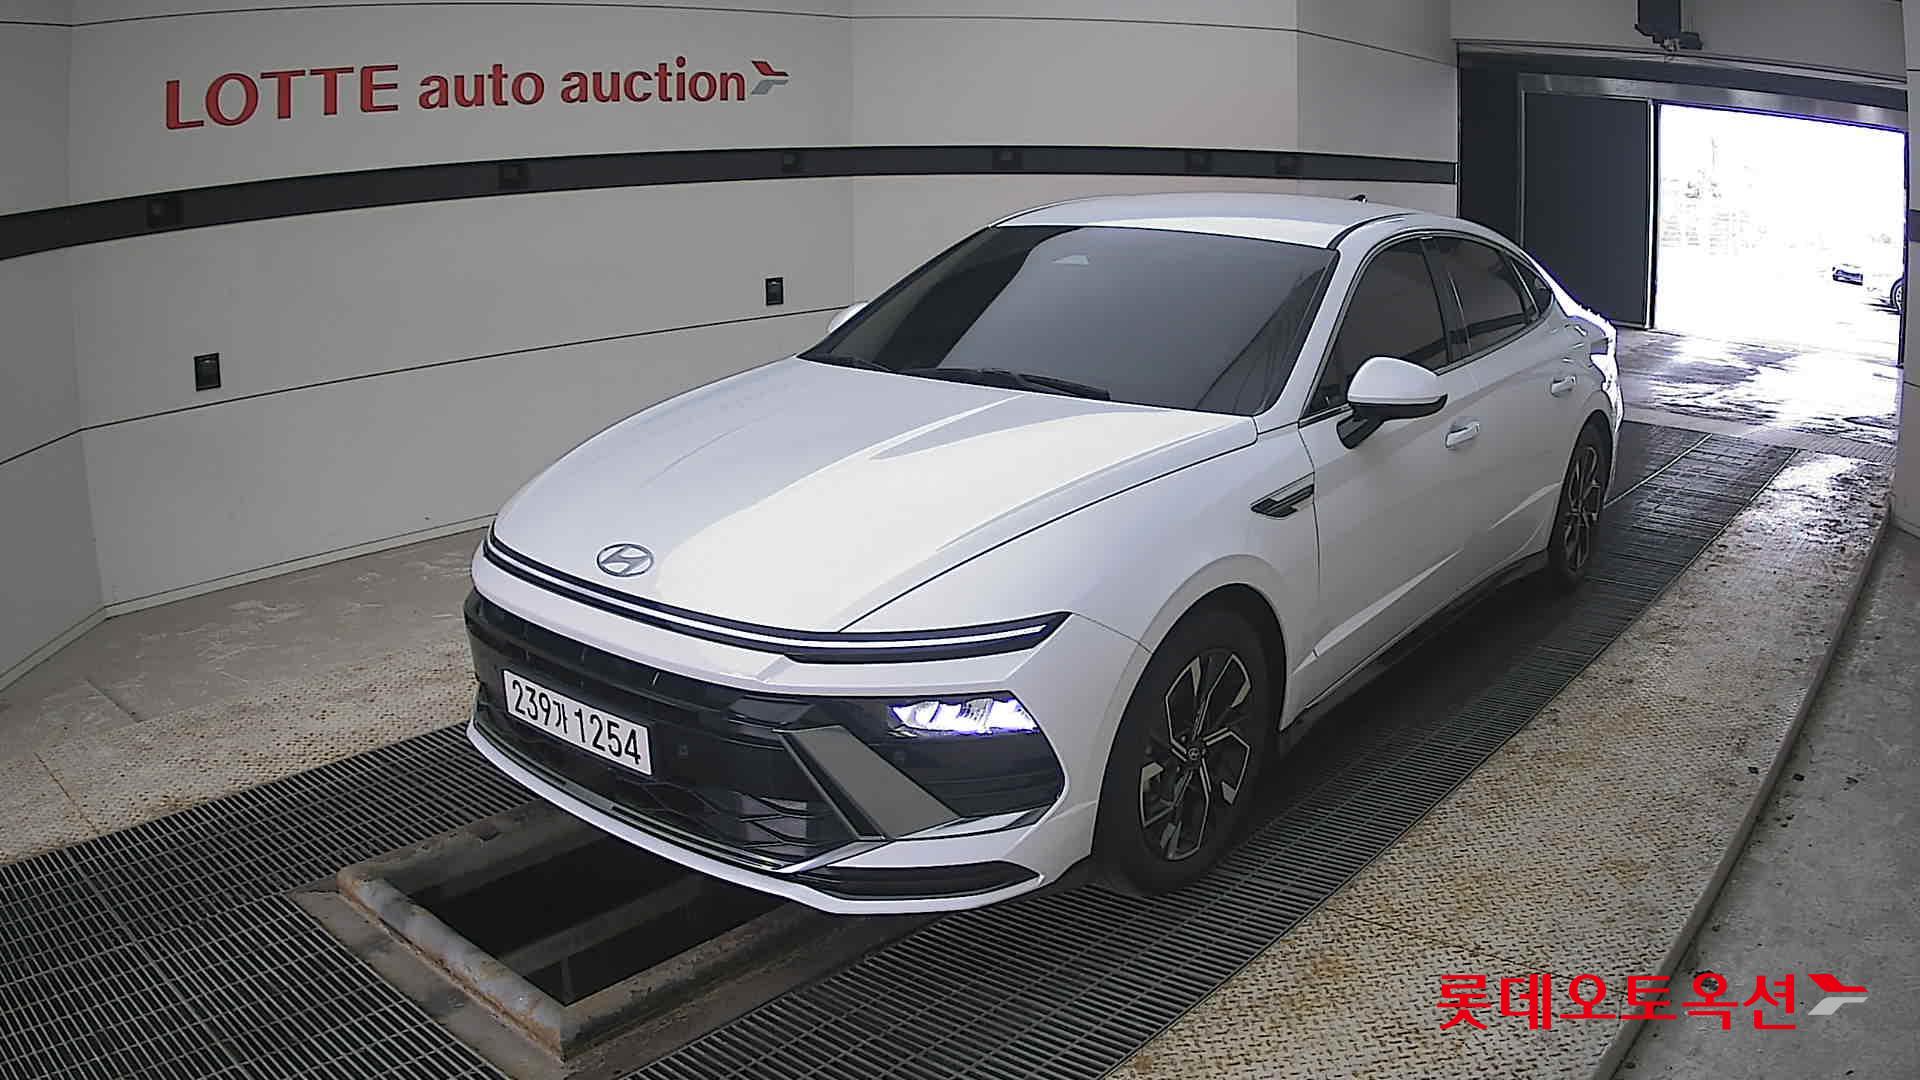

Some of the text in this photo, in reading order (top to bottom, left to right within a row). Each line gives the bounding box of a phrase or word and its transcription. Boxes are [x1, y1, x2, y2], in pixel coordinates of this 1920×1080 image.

[165, 56, 746, 130] LOTTE auto auction
[512, 679, 641, 765] 239가 1254
